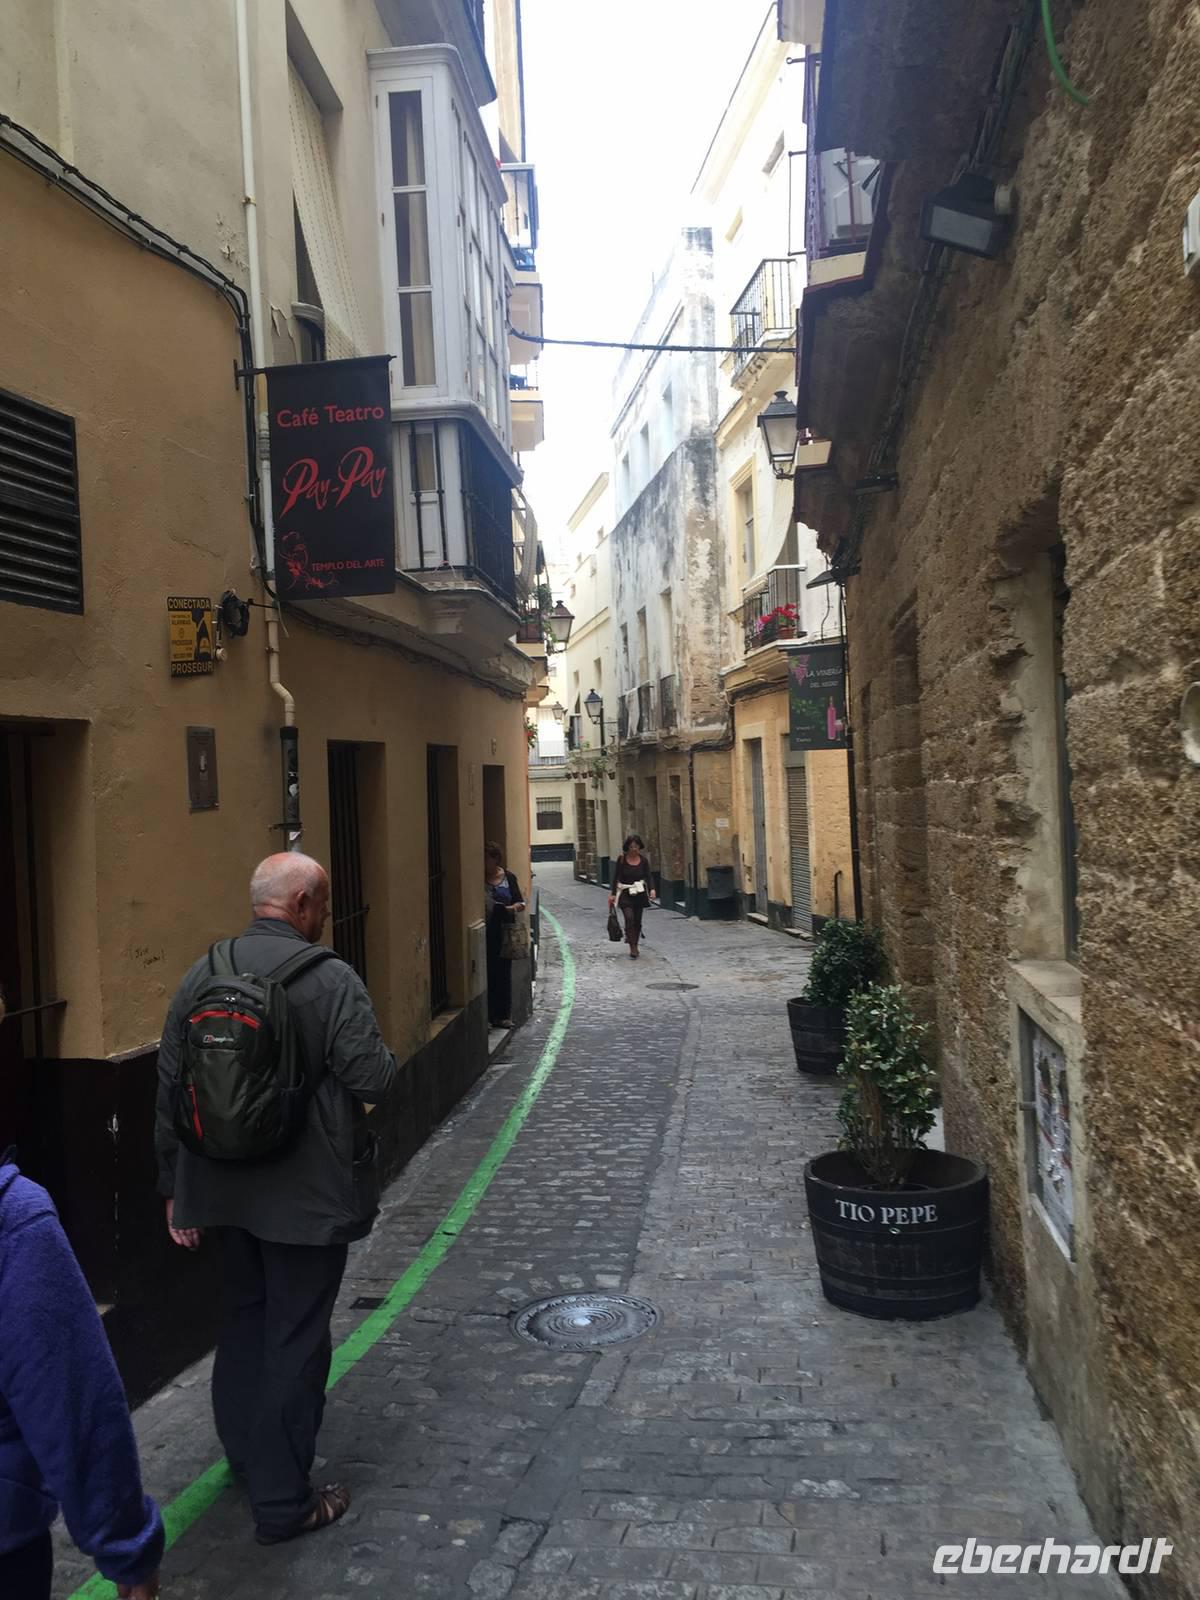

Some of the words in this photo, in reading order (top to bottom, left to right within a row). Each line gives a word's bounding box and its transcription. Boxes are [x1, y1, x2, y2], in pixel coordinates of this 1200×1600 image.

[277, 407, 319, 428] Café
[325, 404, 385, 424] Teatro
[279, 446, 387, 521] Pay-Pay
[312, 561, 345, 573] TEMPLO
[346, 560, 362, 570] DEL
[364, 558, 385, 569] ARTE
[168, 598, 211, 609] CONECTADA
[171, 661, 214, 674] PROSEGUR
[805, 670, 815, 678] LA
[835, 1199, 875, 1222] TIO
[880, 1204, 938, 1225] PEPE
